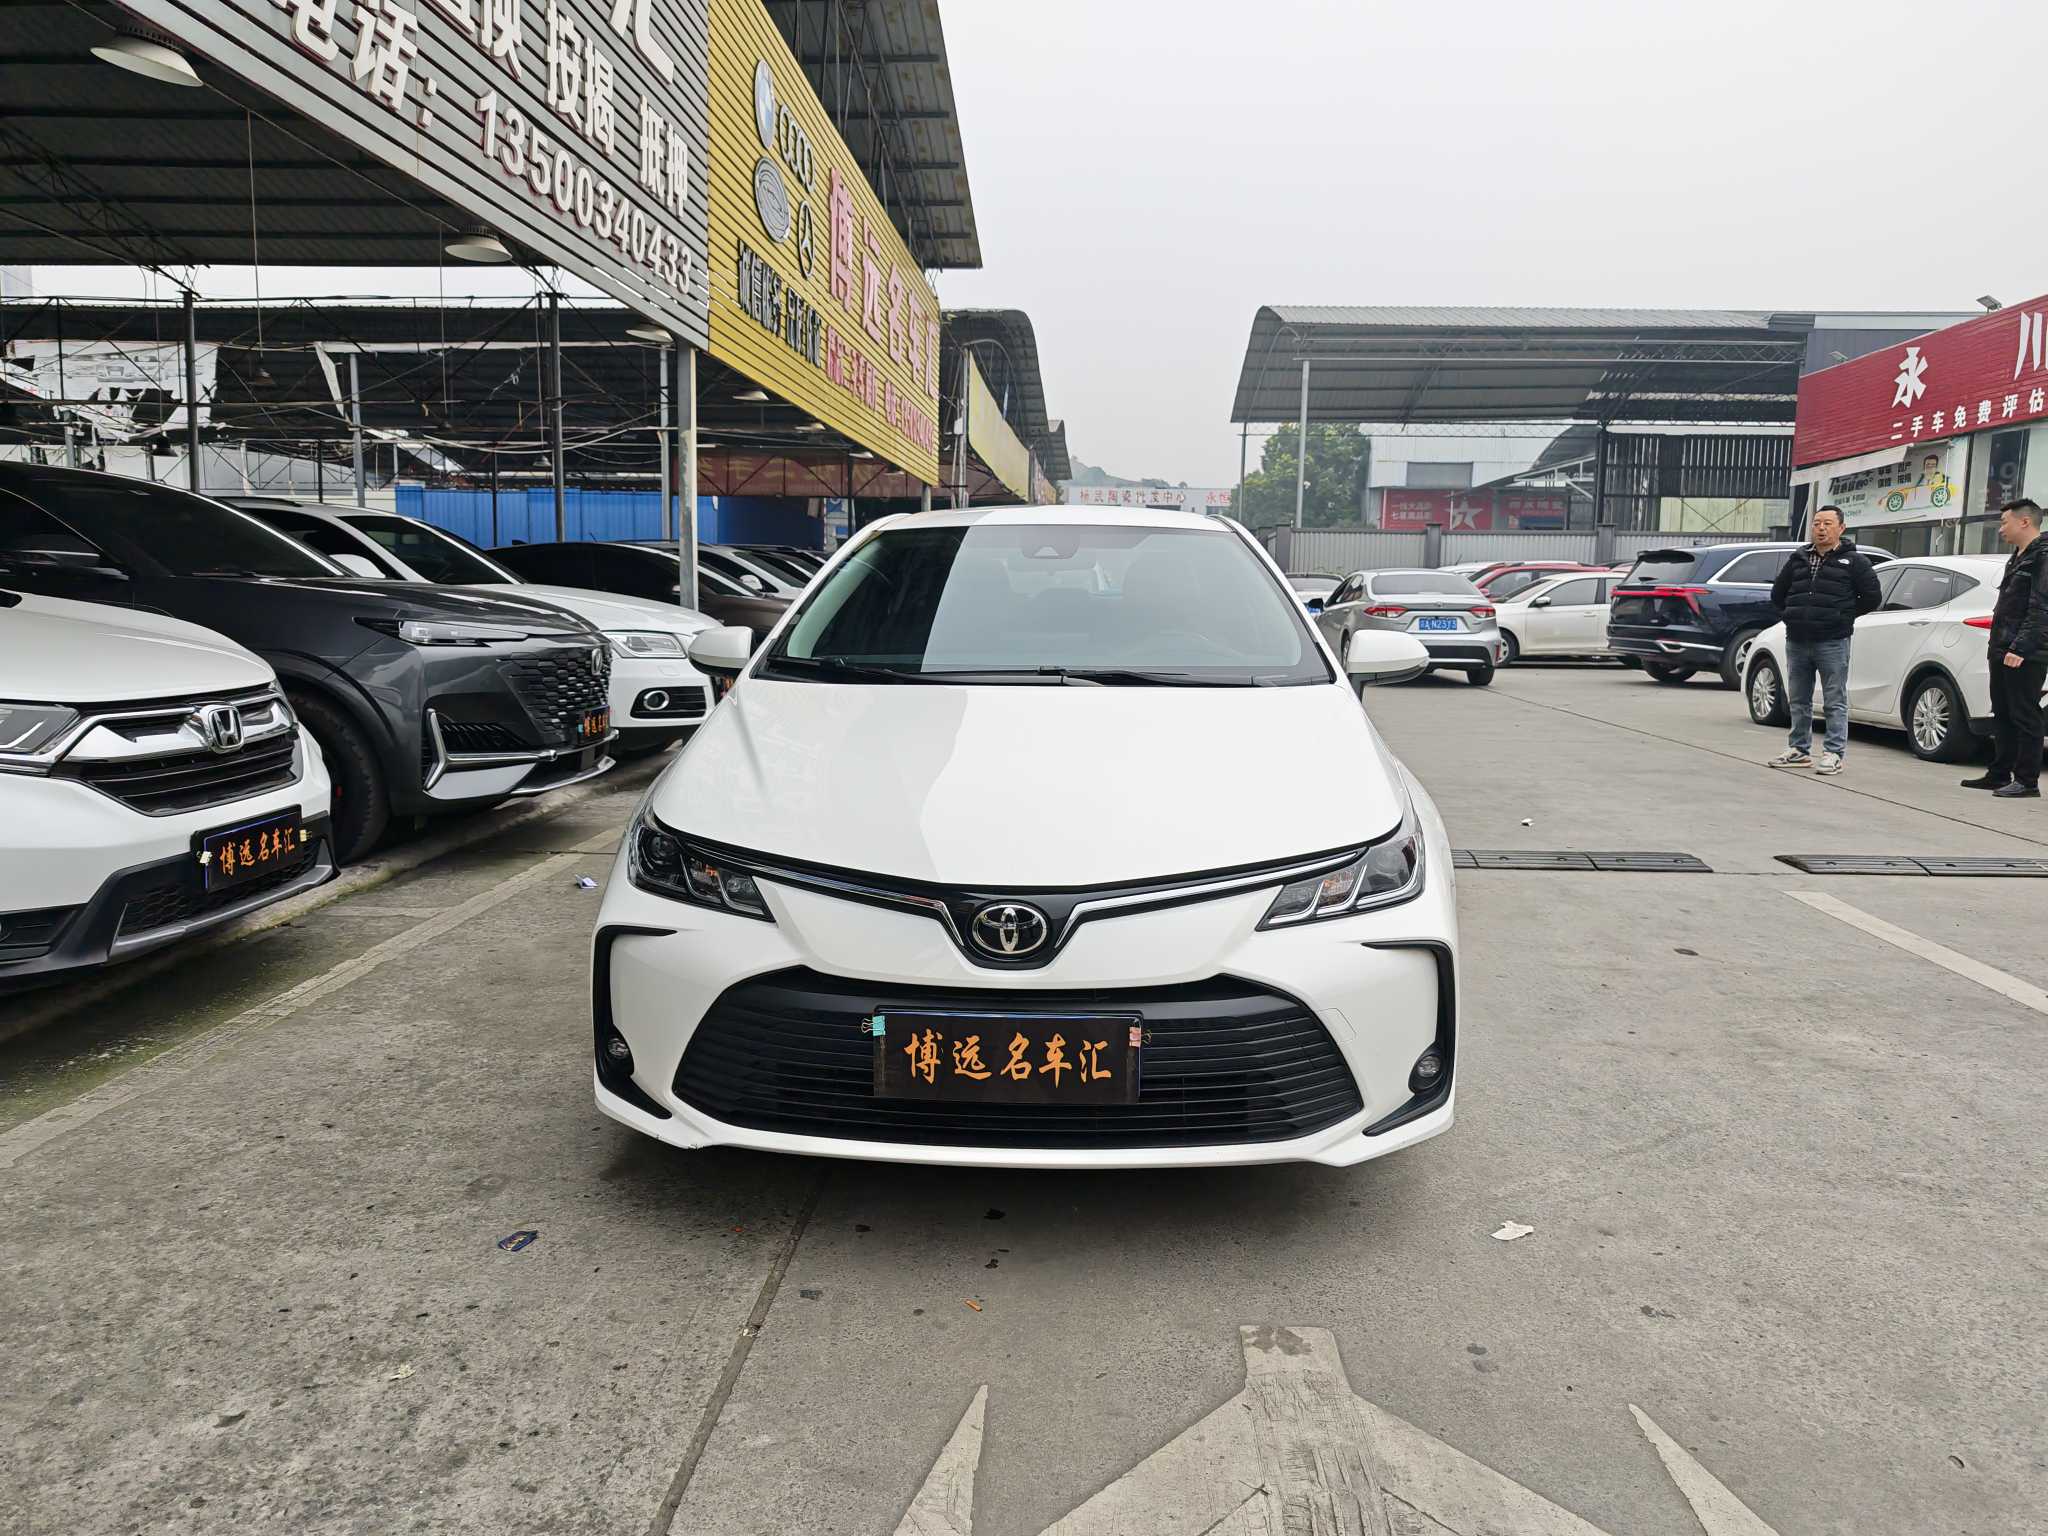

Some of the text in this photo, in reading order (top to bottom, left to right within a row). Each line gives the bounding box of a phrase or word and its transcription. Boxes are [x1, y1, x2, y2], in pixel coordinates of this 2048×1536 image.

[546, 0, 614, 156] 按揭
[638, 94, 688, 218] 抵押
[474, 89, 691, 294] 13500340433
[1890, 387, 2045, 440] 二手车免费评估
[219, 827, 295, 876] 博远名车汇
[904, 1028, 1112, 1088] 博远名车汇
